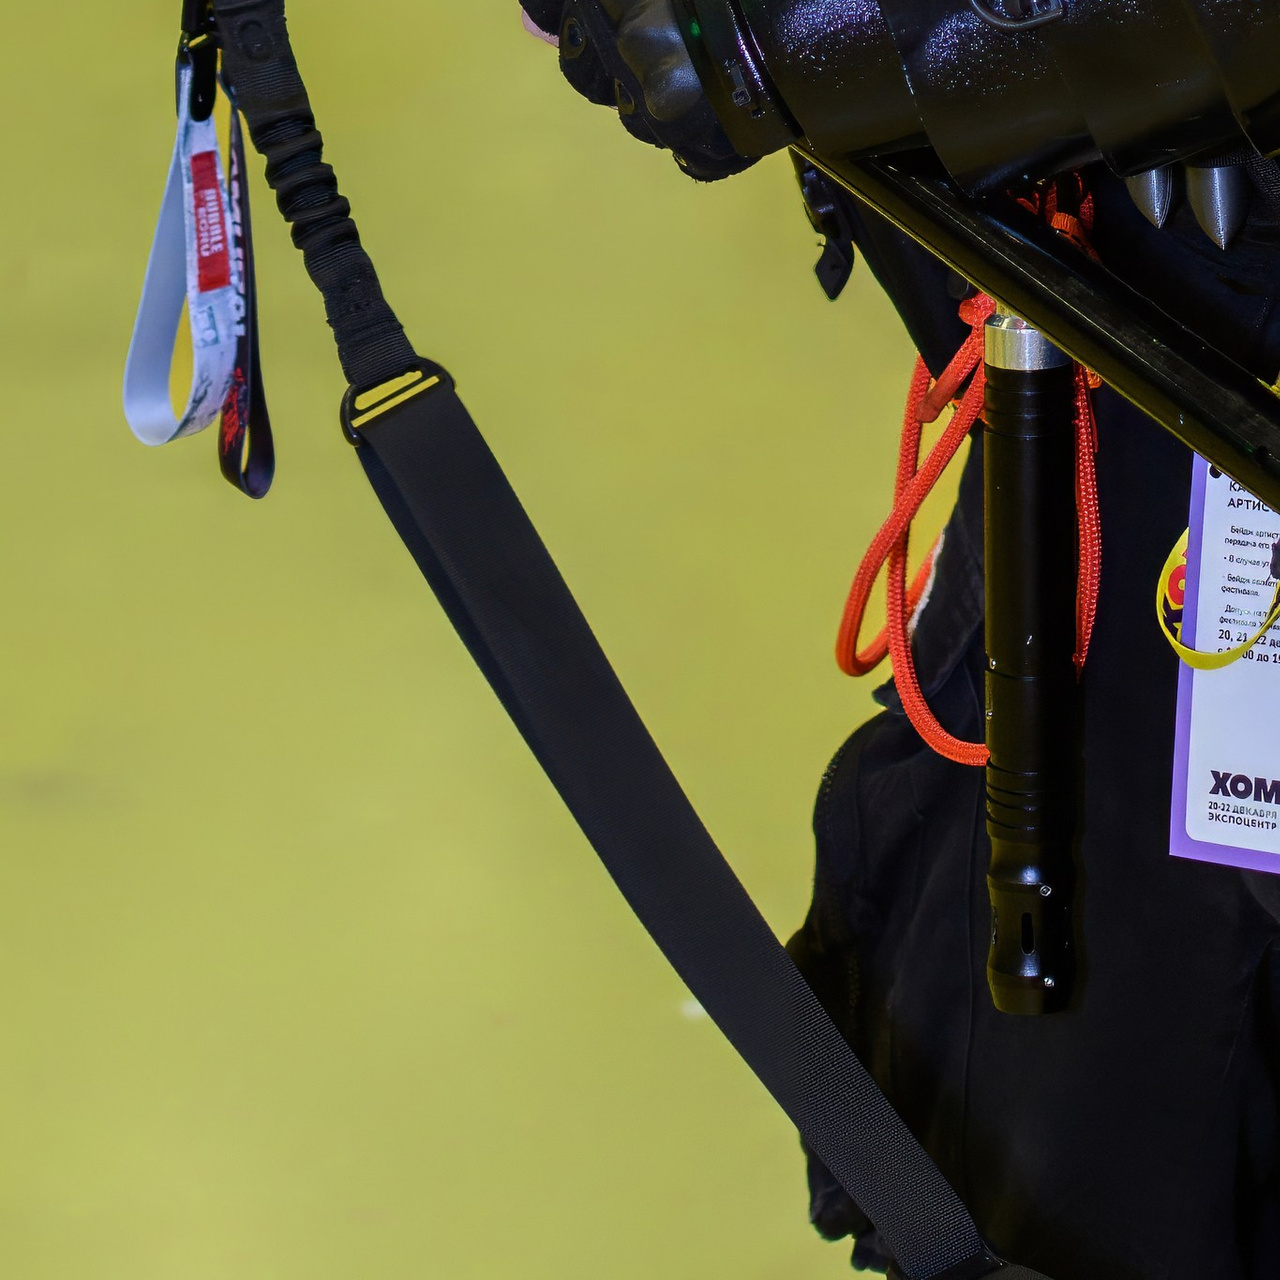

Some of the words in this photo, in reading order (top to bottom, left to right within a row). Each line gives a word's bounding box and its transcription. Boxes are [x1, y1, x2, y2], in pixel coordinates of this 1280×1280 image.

[1227, 498, 1270, 512] АРТИС
[1218, 629, 1234, 642] 20,
[1256, 653, 1269, 663] до
[1208, 812, 1278, 830] ЭКСПОЦЕНТР
